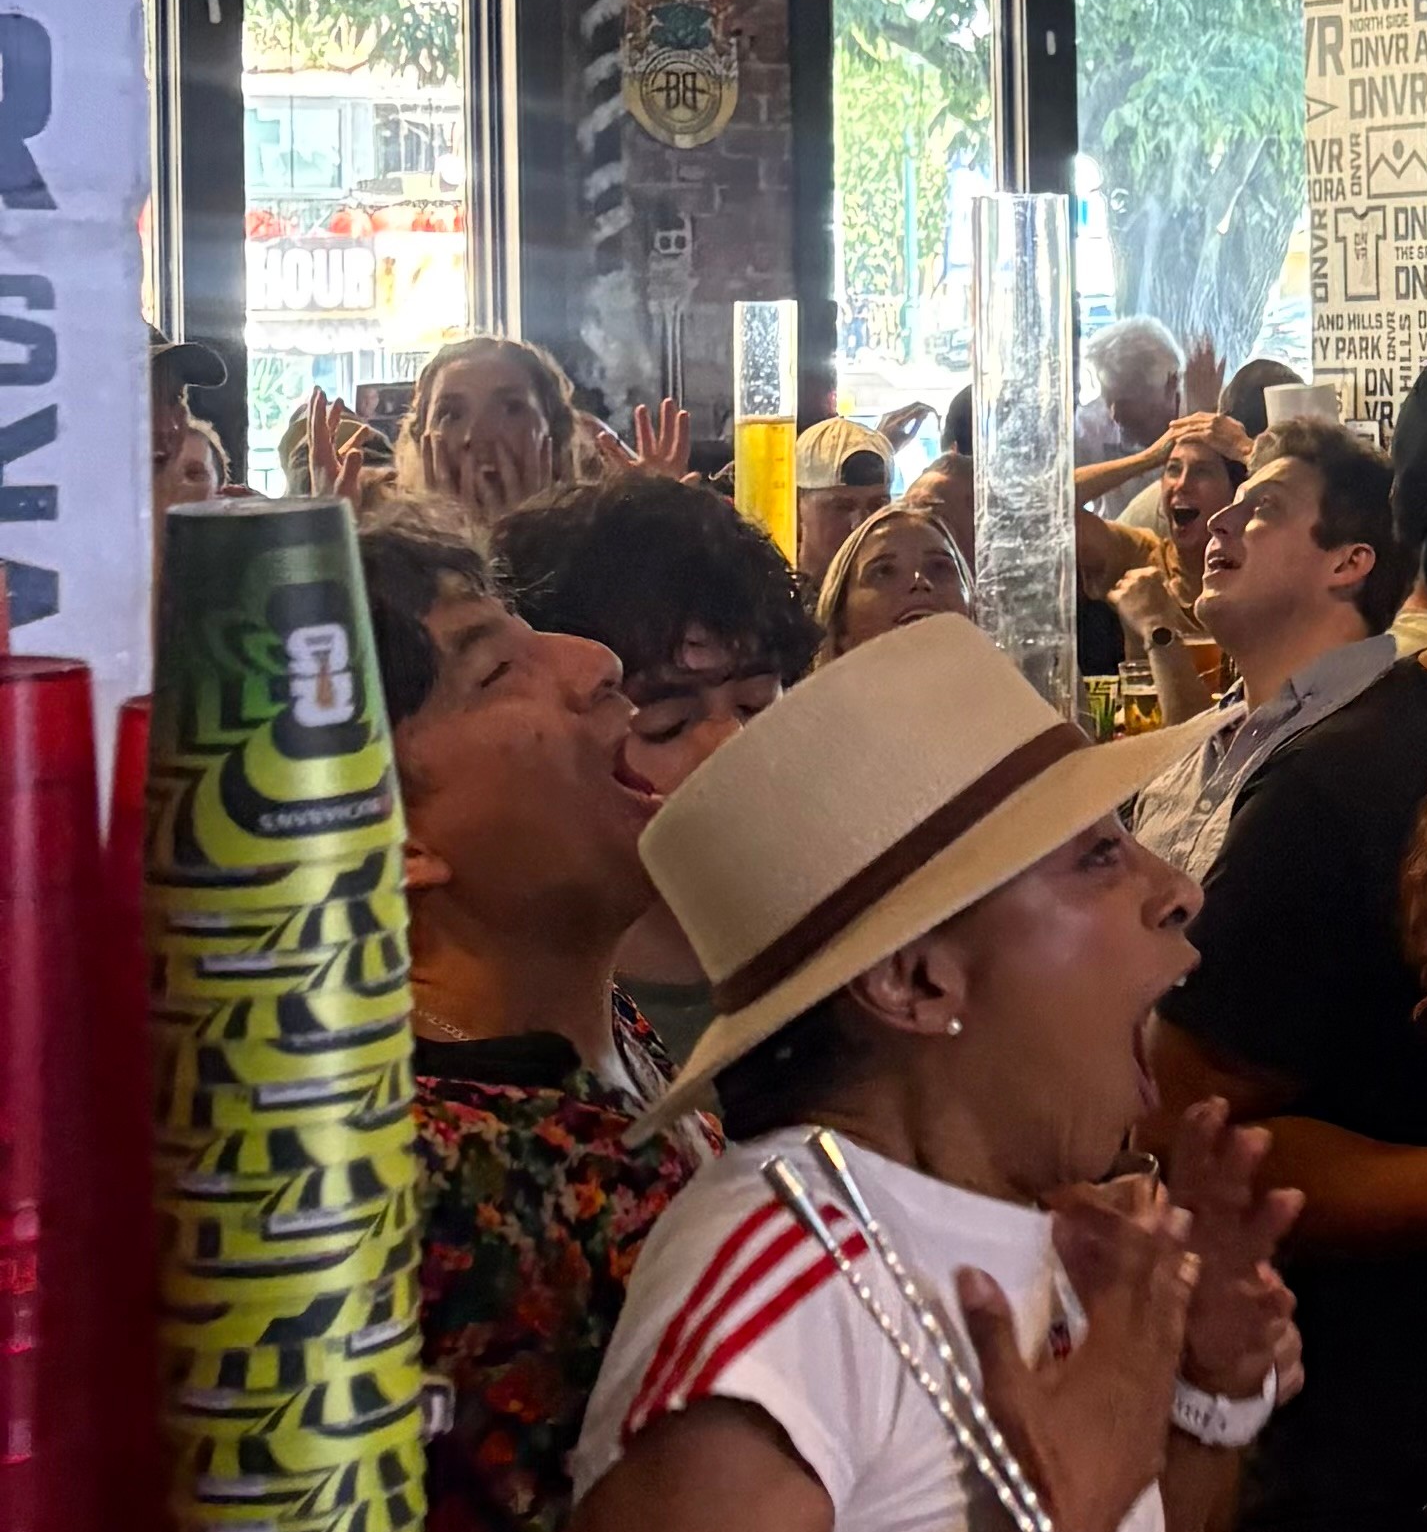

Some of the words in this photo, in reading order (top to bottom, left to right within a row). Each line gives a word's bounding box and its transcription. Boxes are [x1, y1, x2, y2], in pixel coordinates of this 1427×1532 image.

[1350, 34, 1408, 68] DNVR
[1348, 72, 1427, 120] DNVR
[1335, 338, 1382, 361] PARK
